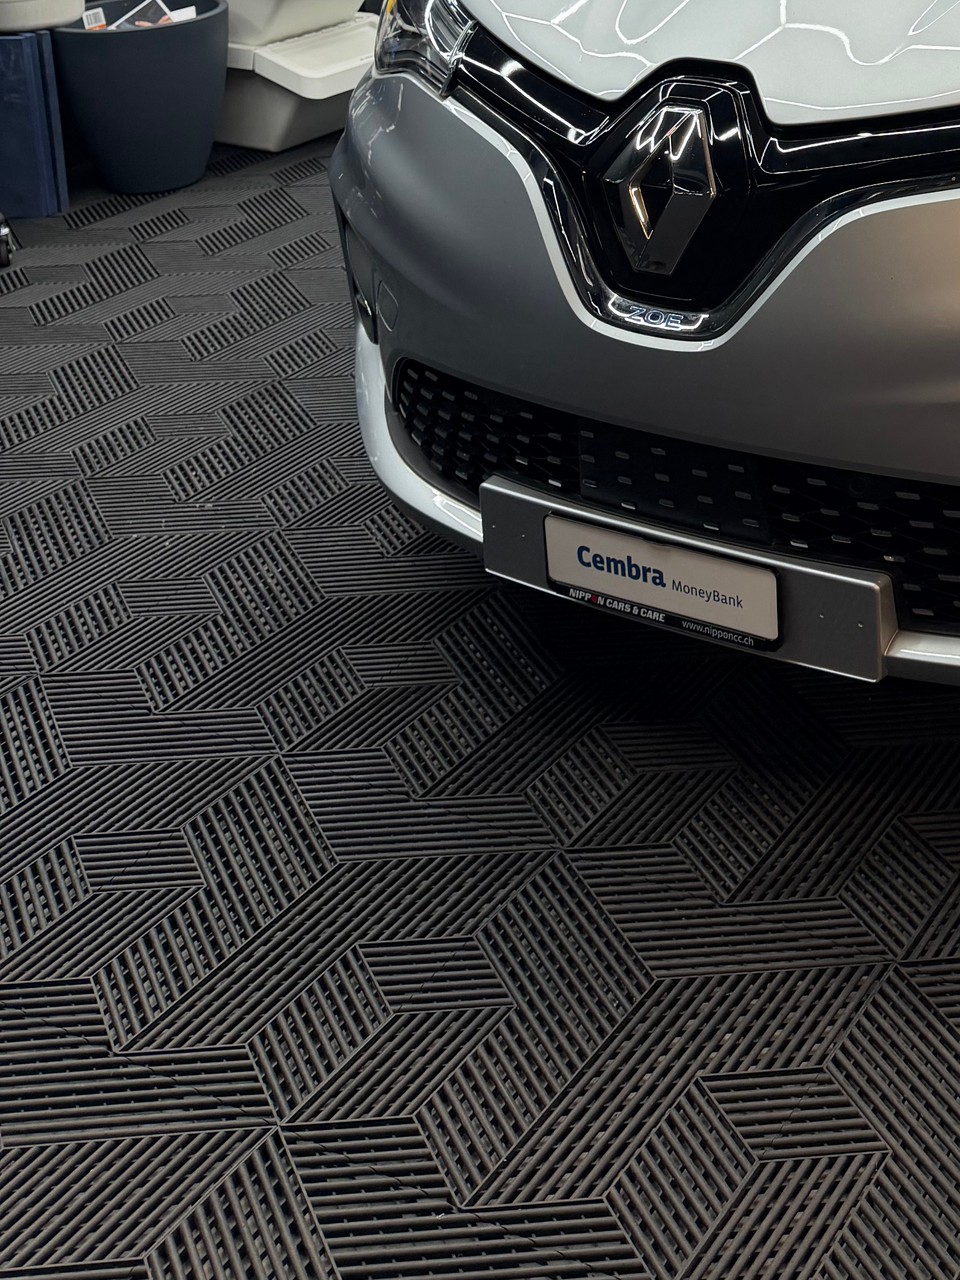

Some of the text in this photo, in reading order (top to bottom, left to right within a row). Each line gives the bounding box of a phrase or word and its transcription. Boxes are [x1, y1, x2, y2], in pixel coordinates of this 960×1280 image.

[625, 305, 684, 331] ZOE
[577, 545, 744, 608] Cembra MoneyBank
[569, 588, 666, 622] NIPPON CARS & CARE
[681, 620, 754, 646] www.nipponcc.ch
